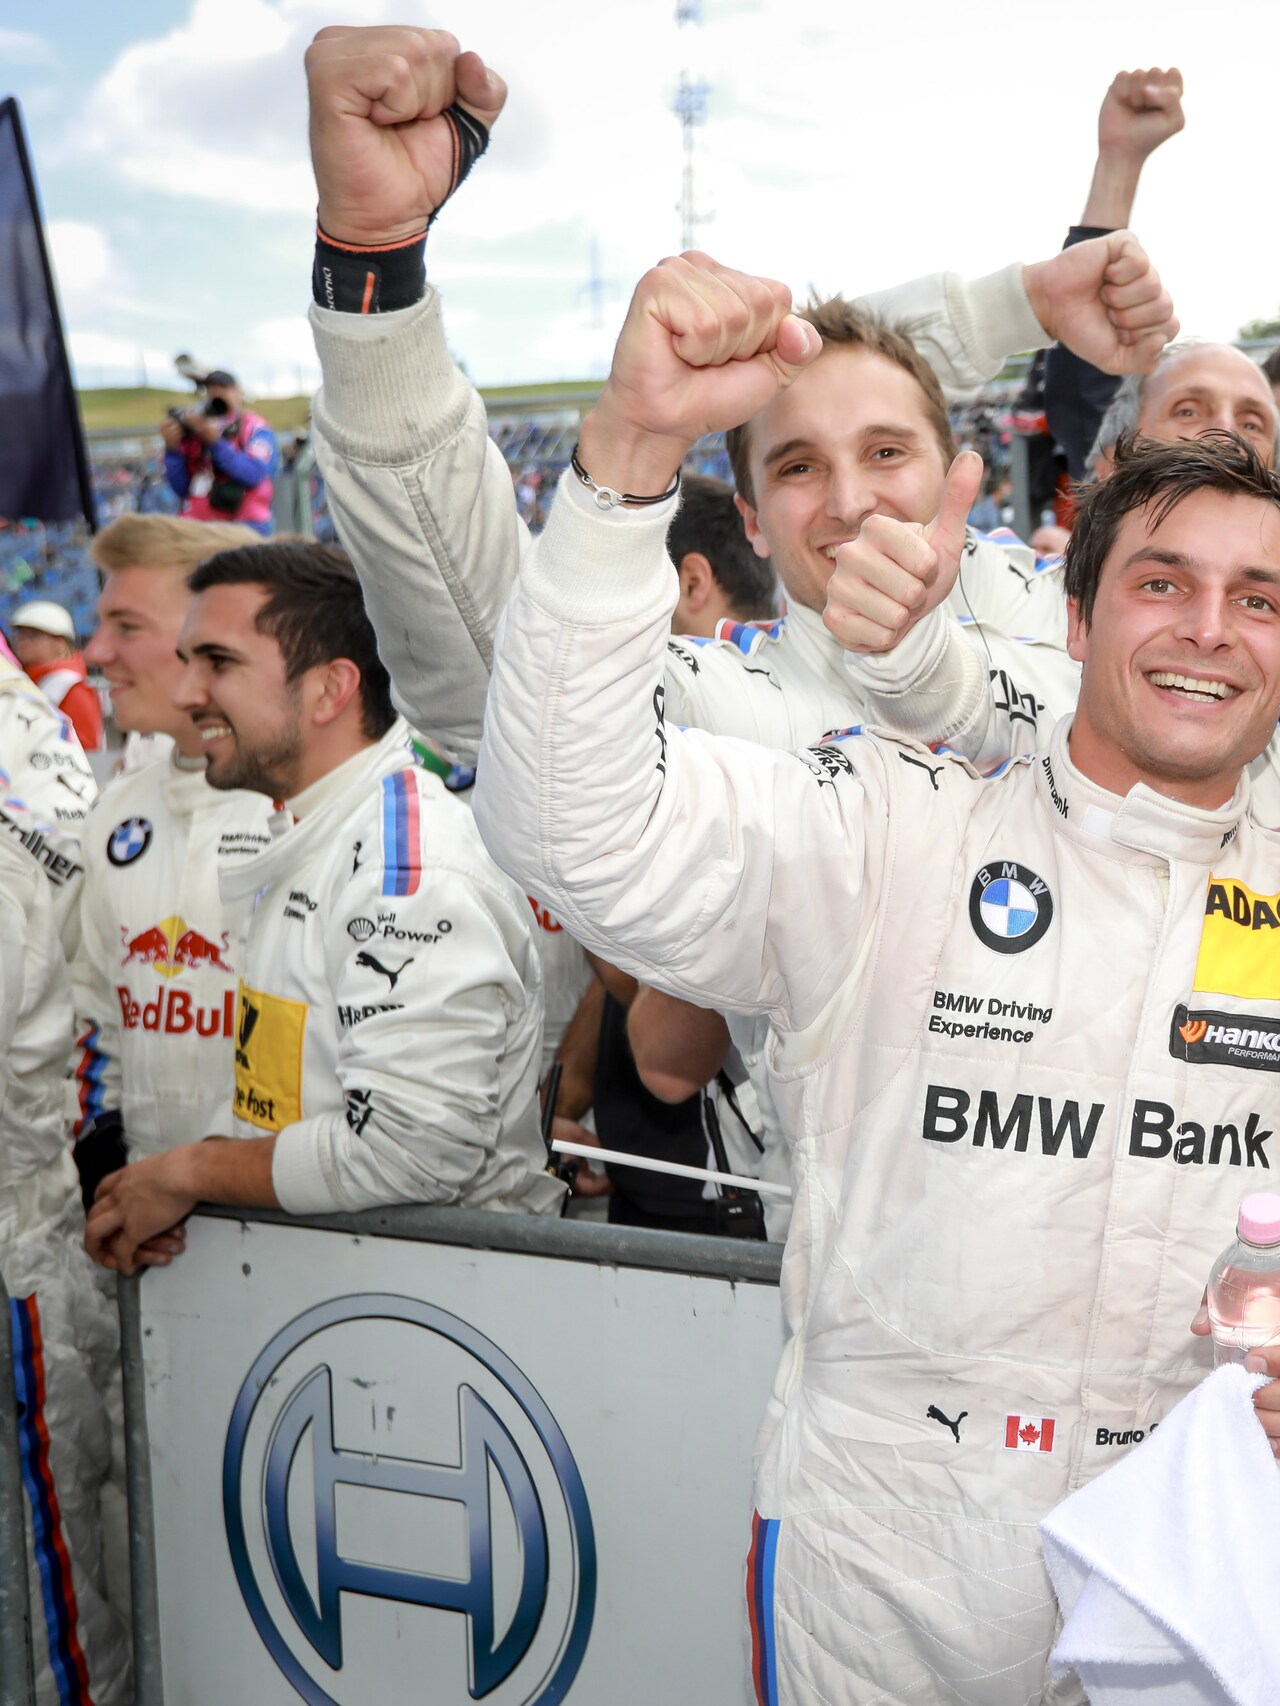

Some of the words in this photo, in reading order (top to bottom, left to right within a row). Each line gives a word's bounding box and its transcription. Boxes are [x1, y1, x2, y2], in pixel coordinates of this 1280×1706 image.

[977, 862, 1048, 896] BMW
[932, 990, 985, 1014] BMW
[987, 997, 1053, 1024] Driving
[928, 1014, 1034, 1044] Experience
[921, 1084, 1106, 1160] BMW
[1128, 1098, 1274, 1170] Bank
[1095, 1427, 1145, 1446] Bruno
